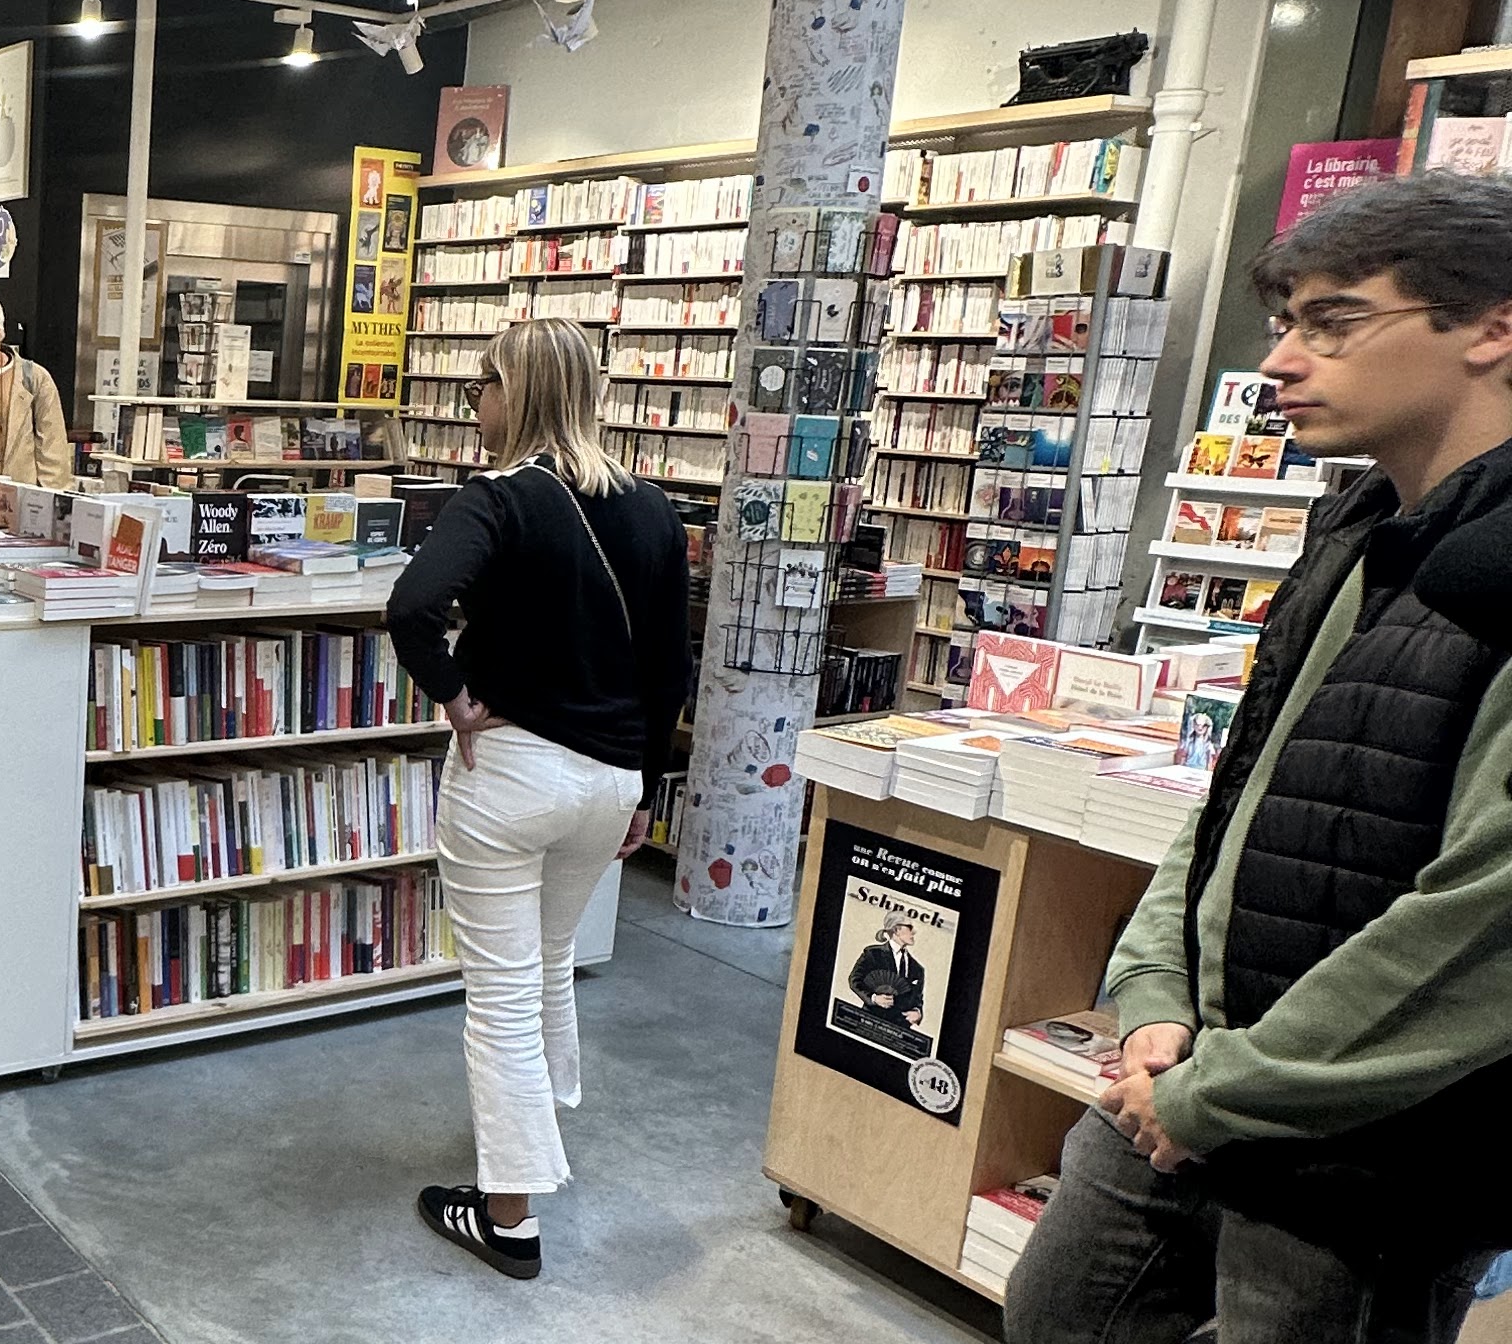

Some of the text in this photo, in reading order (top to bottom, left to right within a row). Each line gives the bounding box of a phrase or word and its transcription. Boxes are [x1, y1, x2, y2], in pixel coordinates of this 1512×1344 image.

[1306, 159, 1323, 174] La
[351, 321, 402, 337] MYTHES
[1219, 414, 1240, 424] DES
[199, 504, 238, 520] Woody
[199, 519, 229, 534] Allen
[199, 539, 228, 555] Zéro
[853, 845, 963, 885] une Revue comme
[851, 856, 869, 868] on
[894, 868, 926, 886] fait
[926, 879, 962, 897] plus
[858, 886, 945, 929] Schnock
